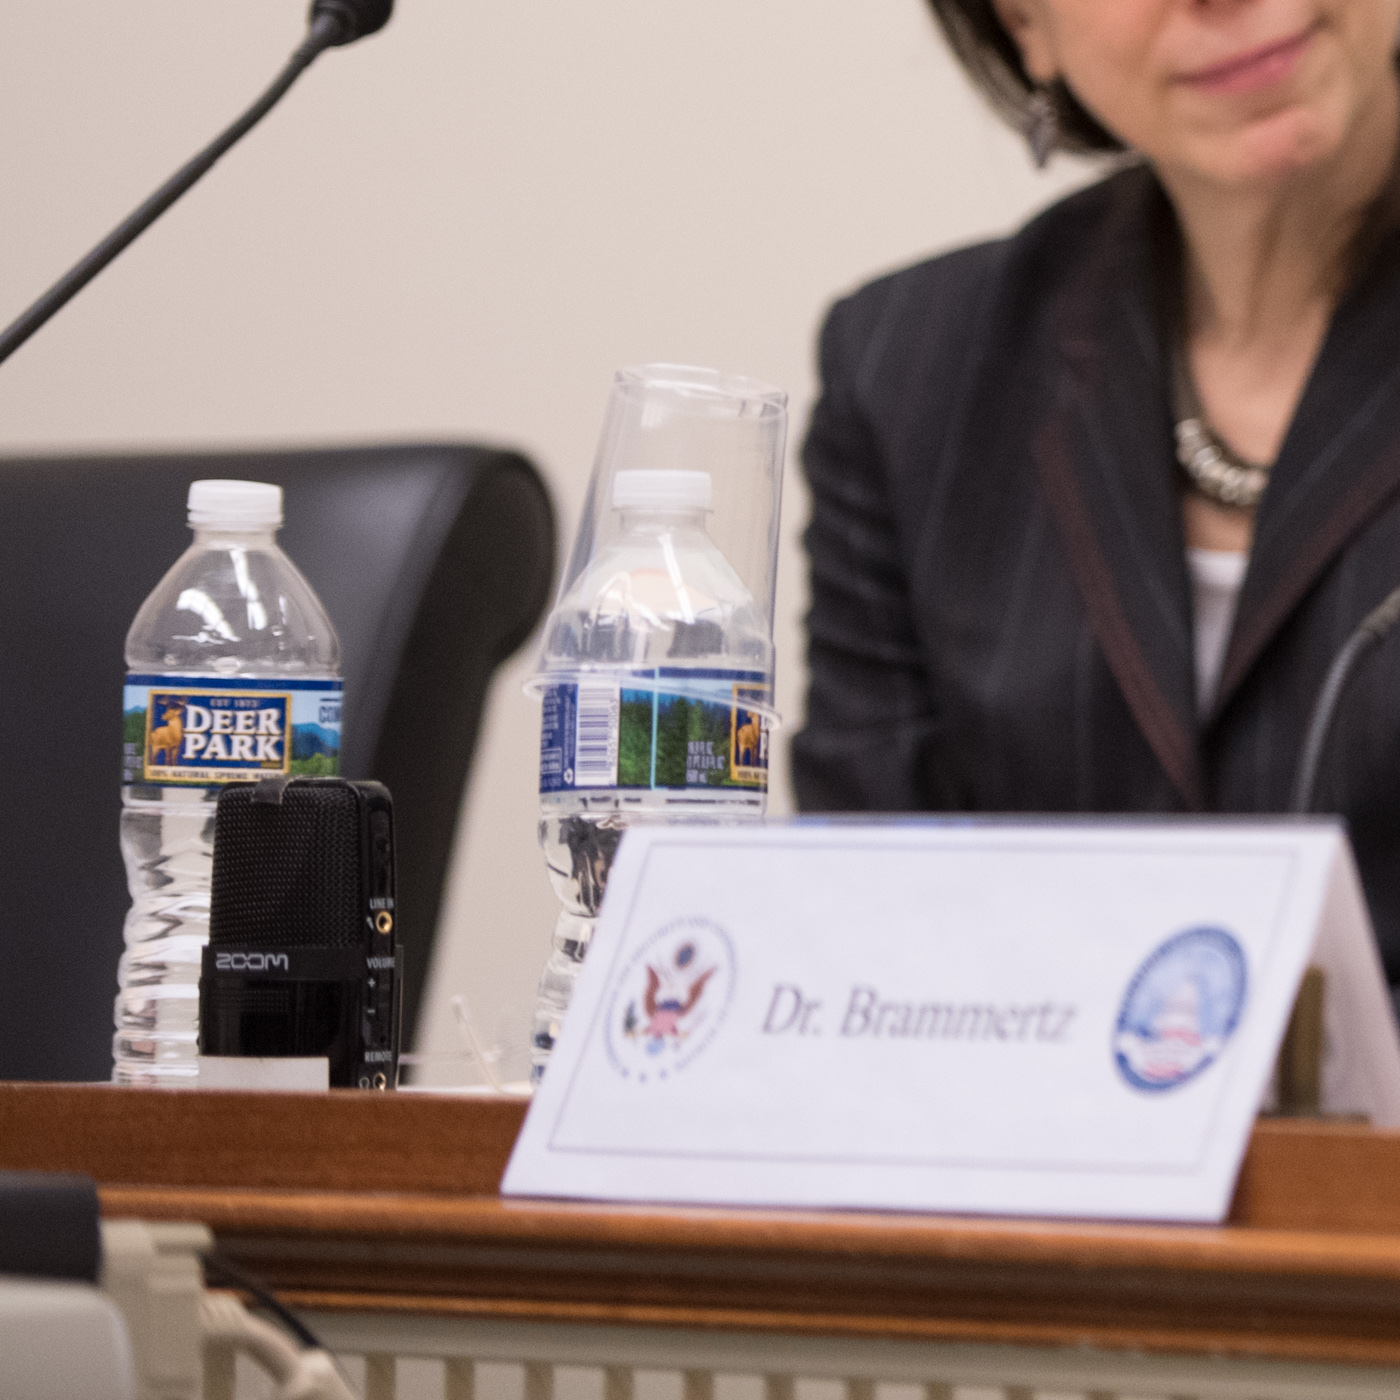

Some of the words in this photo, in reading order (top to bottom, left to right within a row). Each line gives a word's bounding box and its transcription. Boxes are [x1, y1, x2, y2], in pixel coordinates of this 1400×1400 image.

[184, 703, 282, 736] DEER
[182, 733, 283, 762] PARK
[216, 952, 289, 971] ZOOM
[761, 983, 822, 1037] Dr.
[840, 983, 1078, 1043] Brammertz
[364, 1050, 393, 1063] REMOTE
